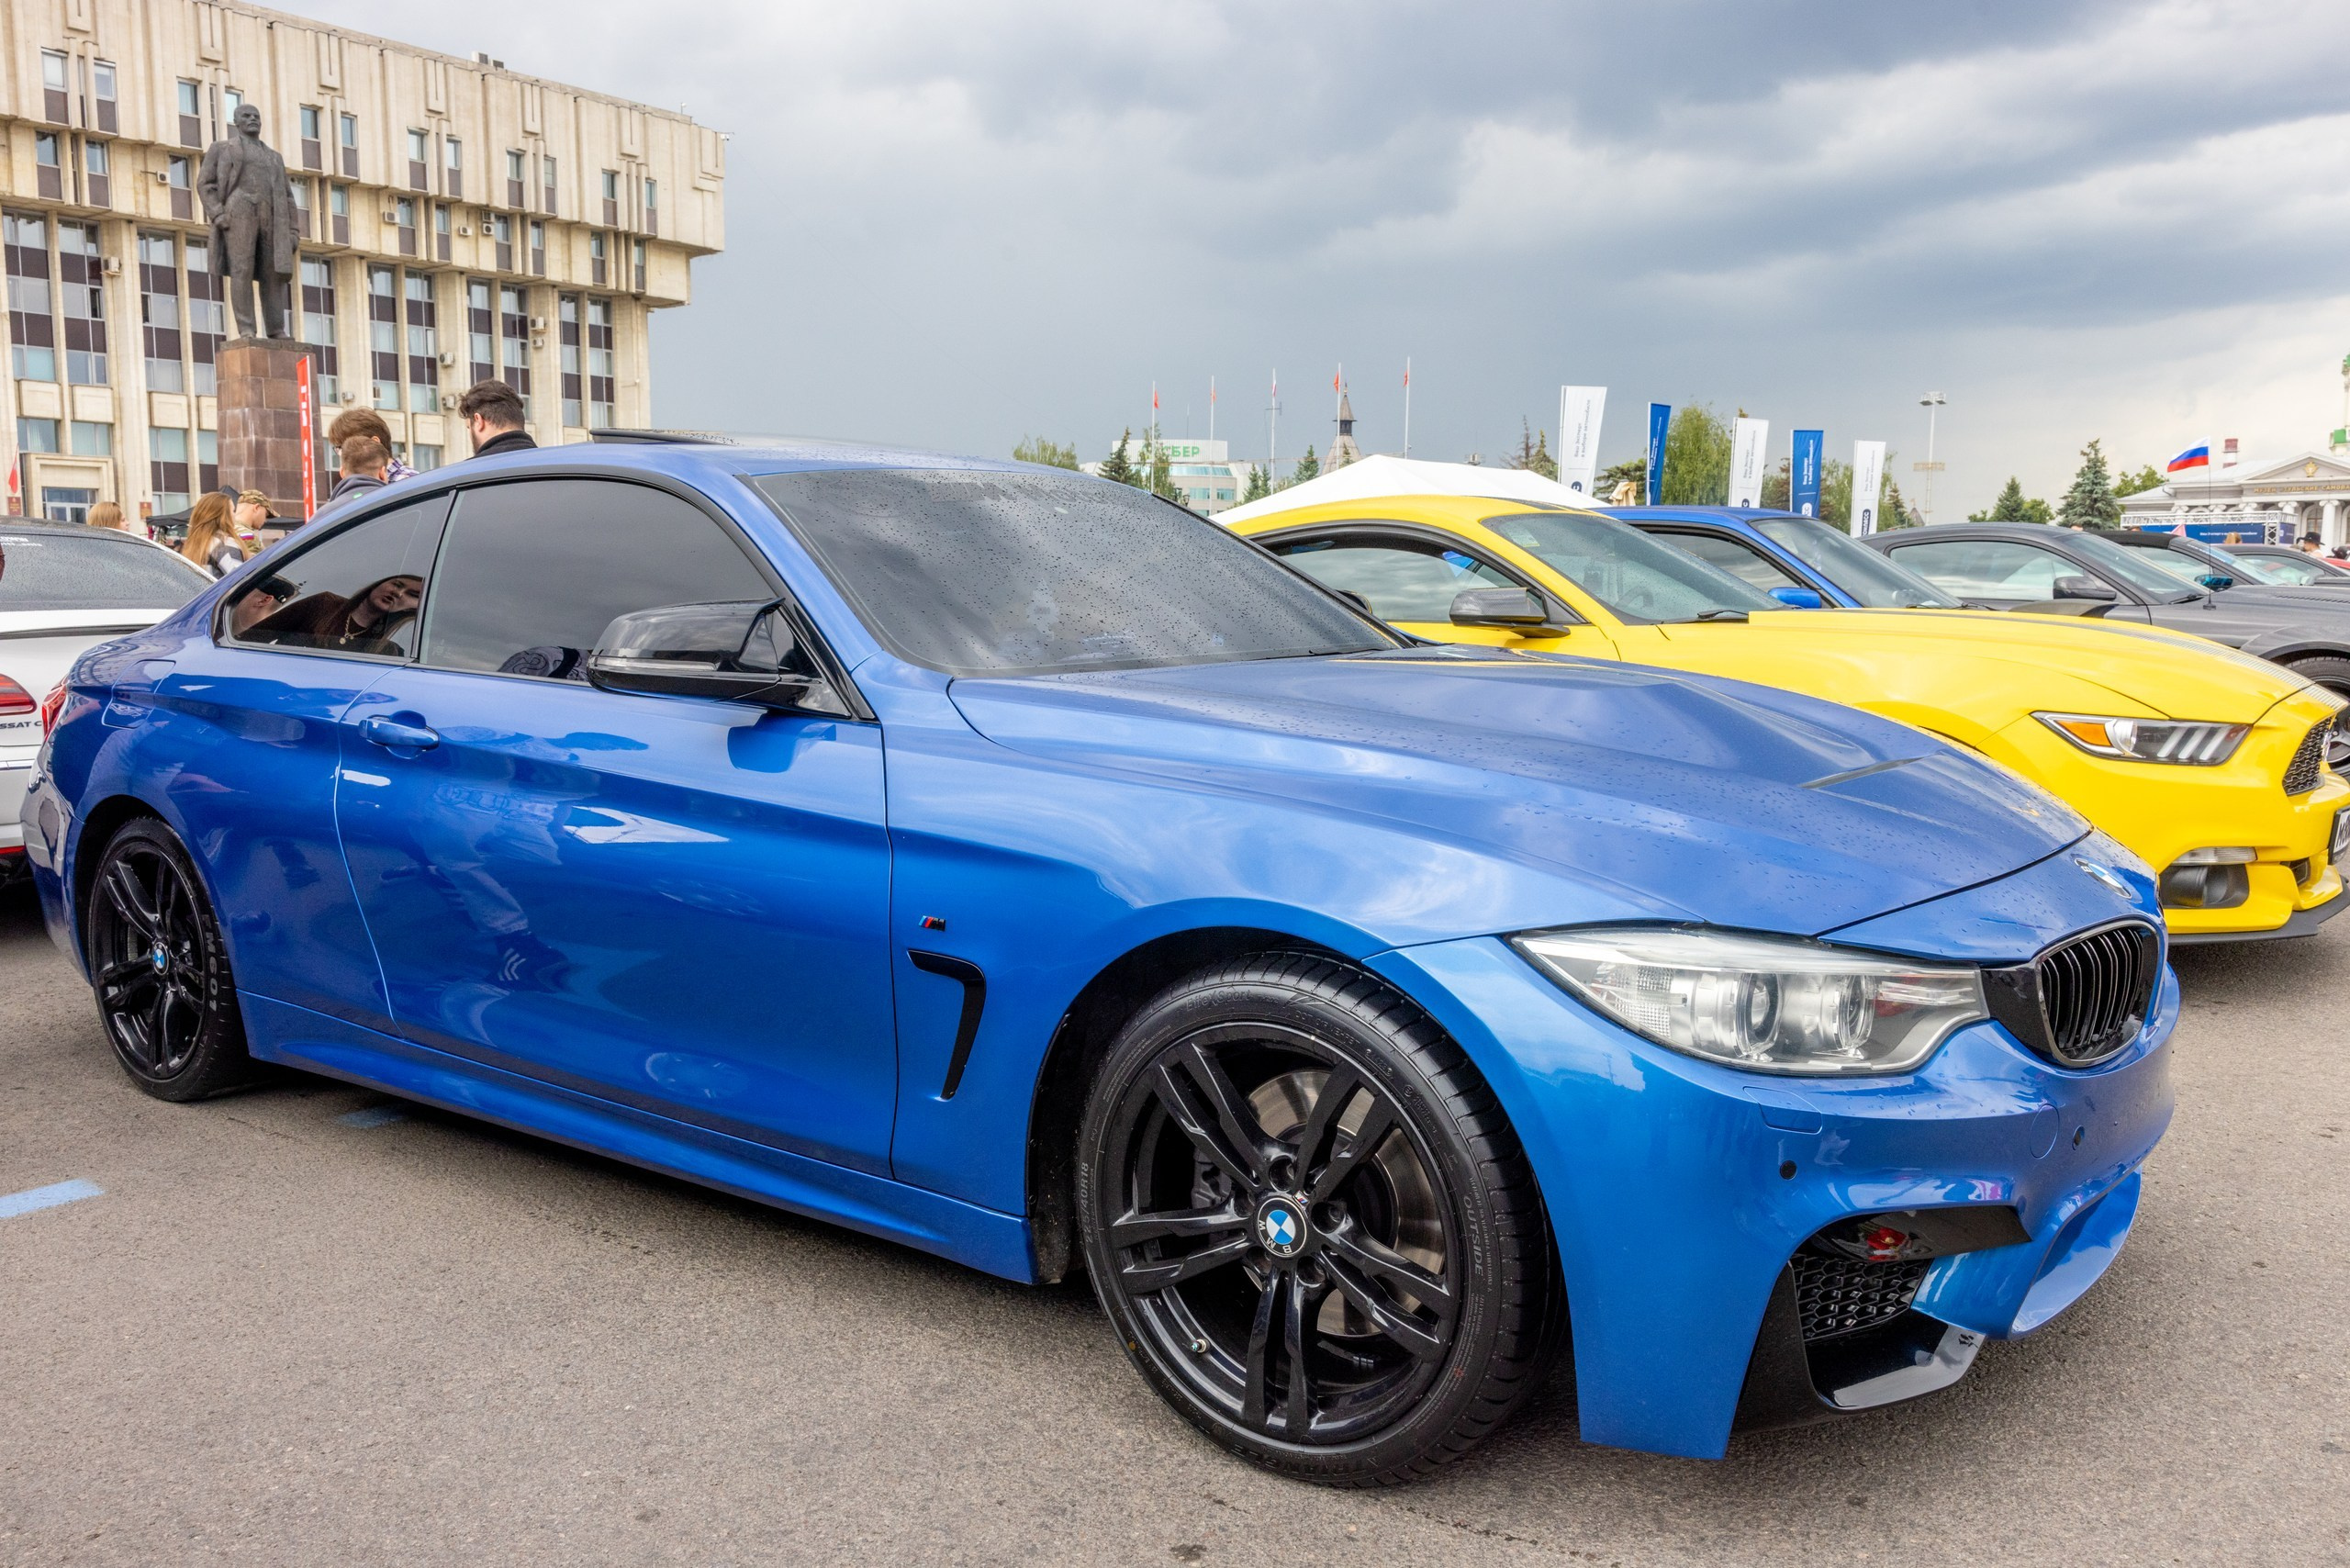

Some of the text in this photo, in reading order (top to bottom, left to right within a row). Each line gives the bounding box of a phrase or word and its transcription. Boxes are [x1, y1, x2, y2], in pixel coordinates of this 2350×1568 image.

[0, 721, 32, 730] SSAT
[1259, 1219, 1292, 1254] BMW
[1463, 1195, 1483, 1277] OUTSIDE
